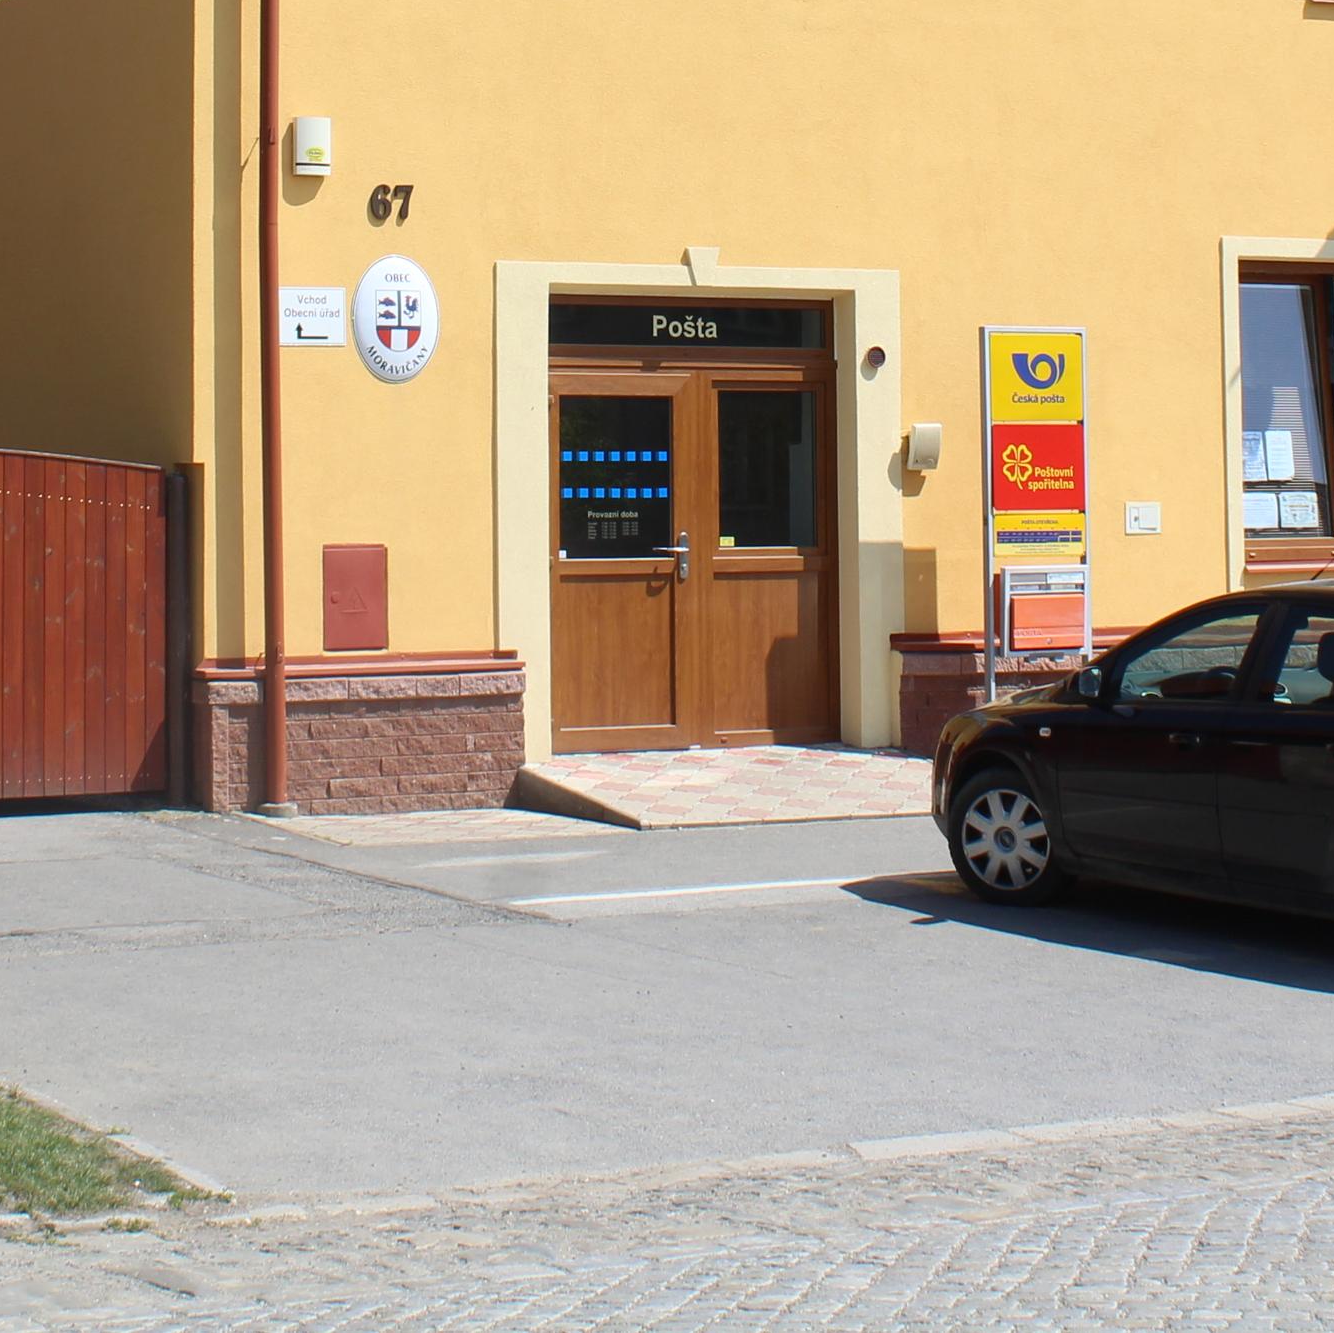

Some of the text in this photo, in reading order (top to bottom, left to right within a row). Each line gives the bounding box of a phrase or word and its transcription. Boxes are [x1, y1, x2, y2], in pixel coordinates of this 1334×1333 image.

[370, 183, 414, 220] 67
[384, 273, 411, 283] OBEC
[297, 295, 327, 305] Vchod
[283, 307, 340, 318] Obecní úřad
[652, 314, 718, 338] Pošta
[366, 344, 428, 375] MORAVIČANY
[1012, 392, 1065, 405] Česká pošta
[1034, 465, 1074, 478] Poštovní
[1028, 478, 1074, 492] spořitelna
[620, 510, 639, 518] doba
